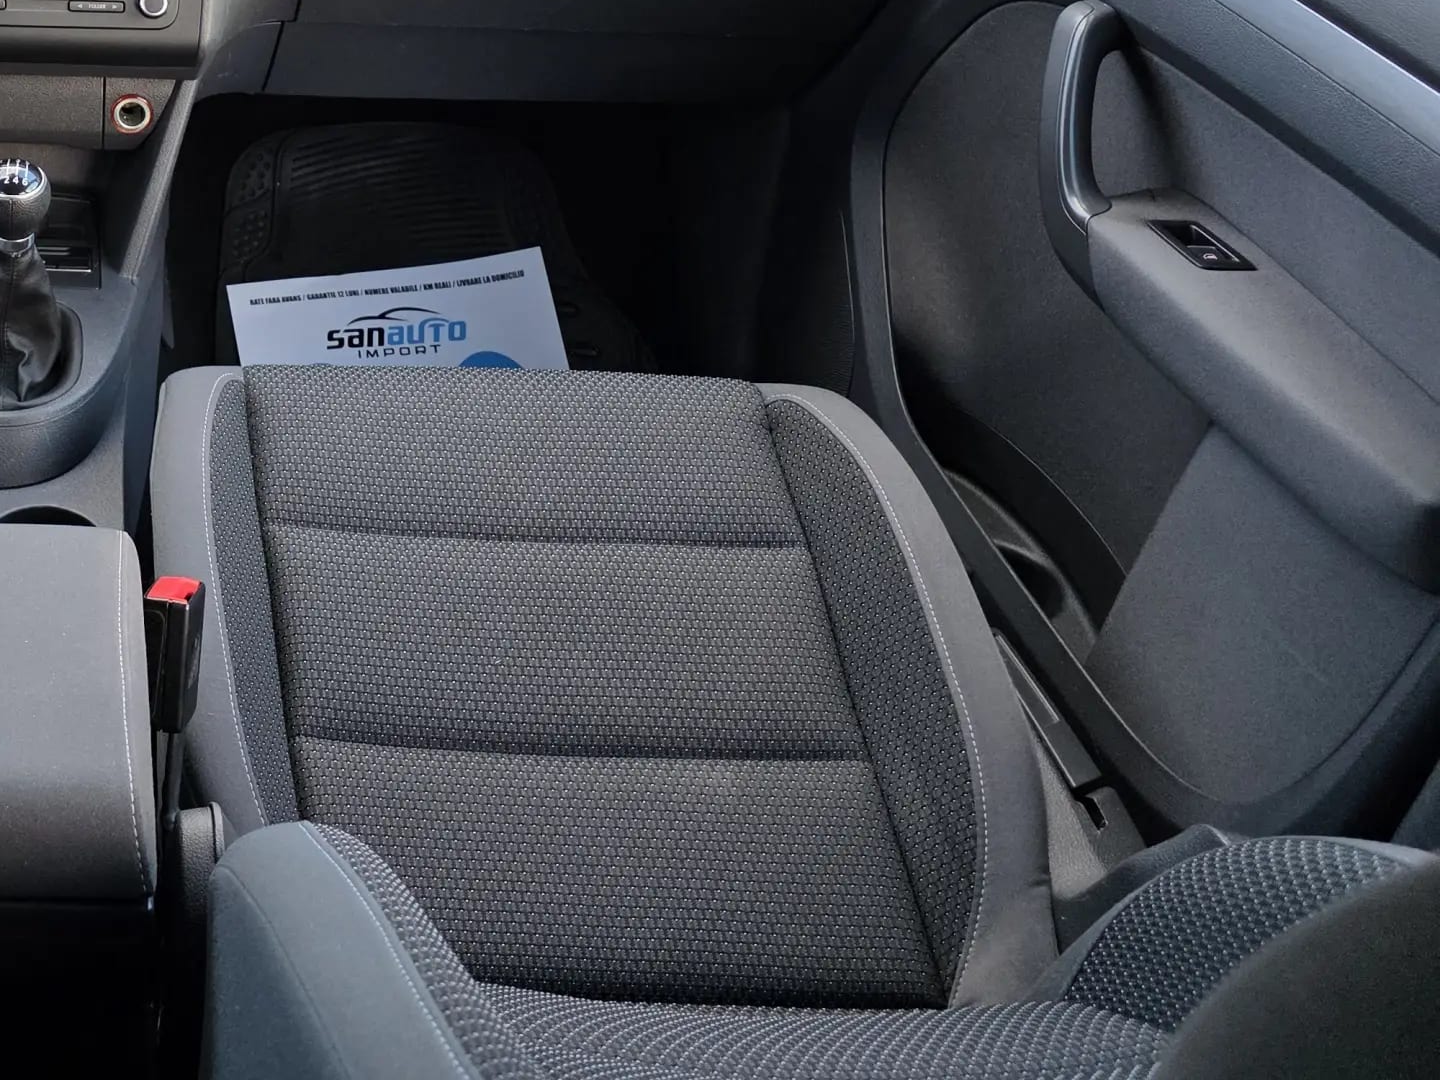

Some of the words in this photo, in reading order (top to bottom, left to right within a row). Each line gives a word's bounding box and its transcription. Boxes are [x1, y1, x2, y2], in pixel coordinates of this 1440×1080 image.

[3, 175, 10, 184] 2
[12, 176, 19, 184] 4
[21, 177, 29, 186] 6
[423, 283, 434, 291] KM
[482, 275, 491, 284] LA
[326, 317, 467, 350] sanauto
[357, 344, 442, 359] IMPORT
